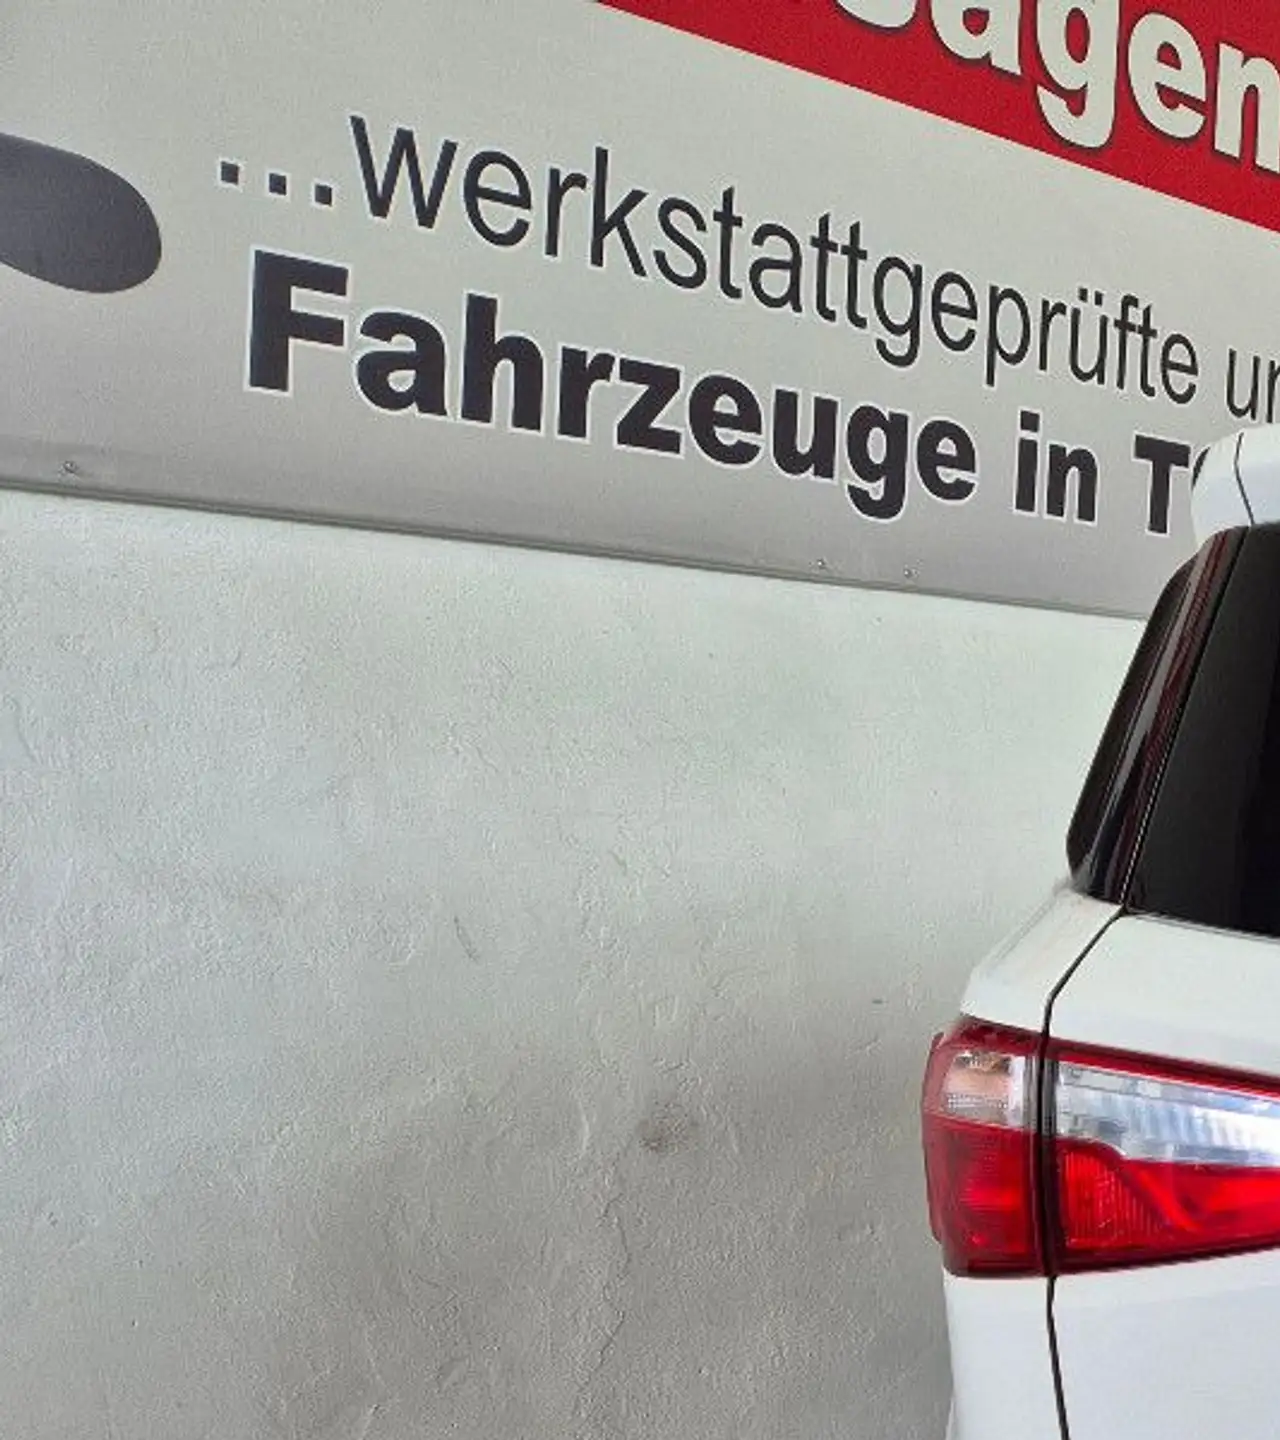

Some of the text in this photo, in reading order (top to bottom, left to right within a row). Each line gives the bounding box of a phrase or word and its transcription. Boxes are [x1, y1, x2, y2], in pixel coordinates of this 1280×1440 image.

[248, 249, 1209, 535] Fahrzeuge in T
